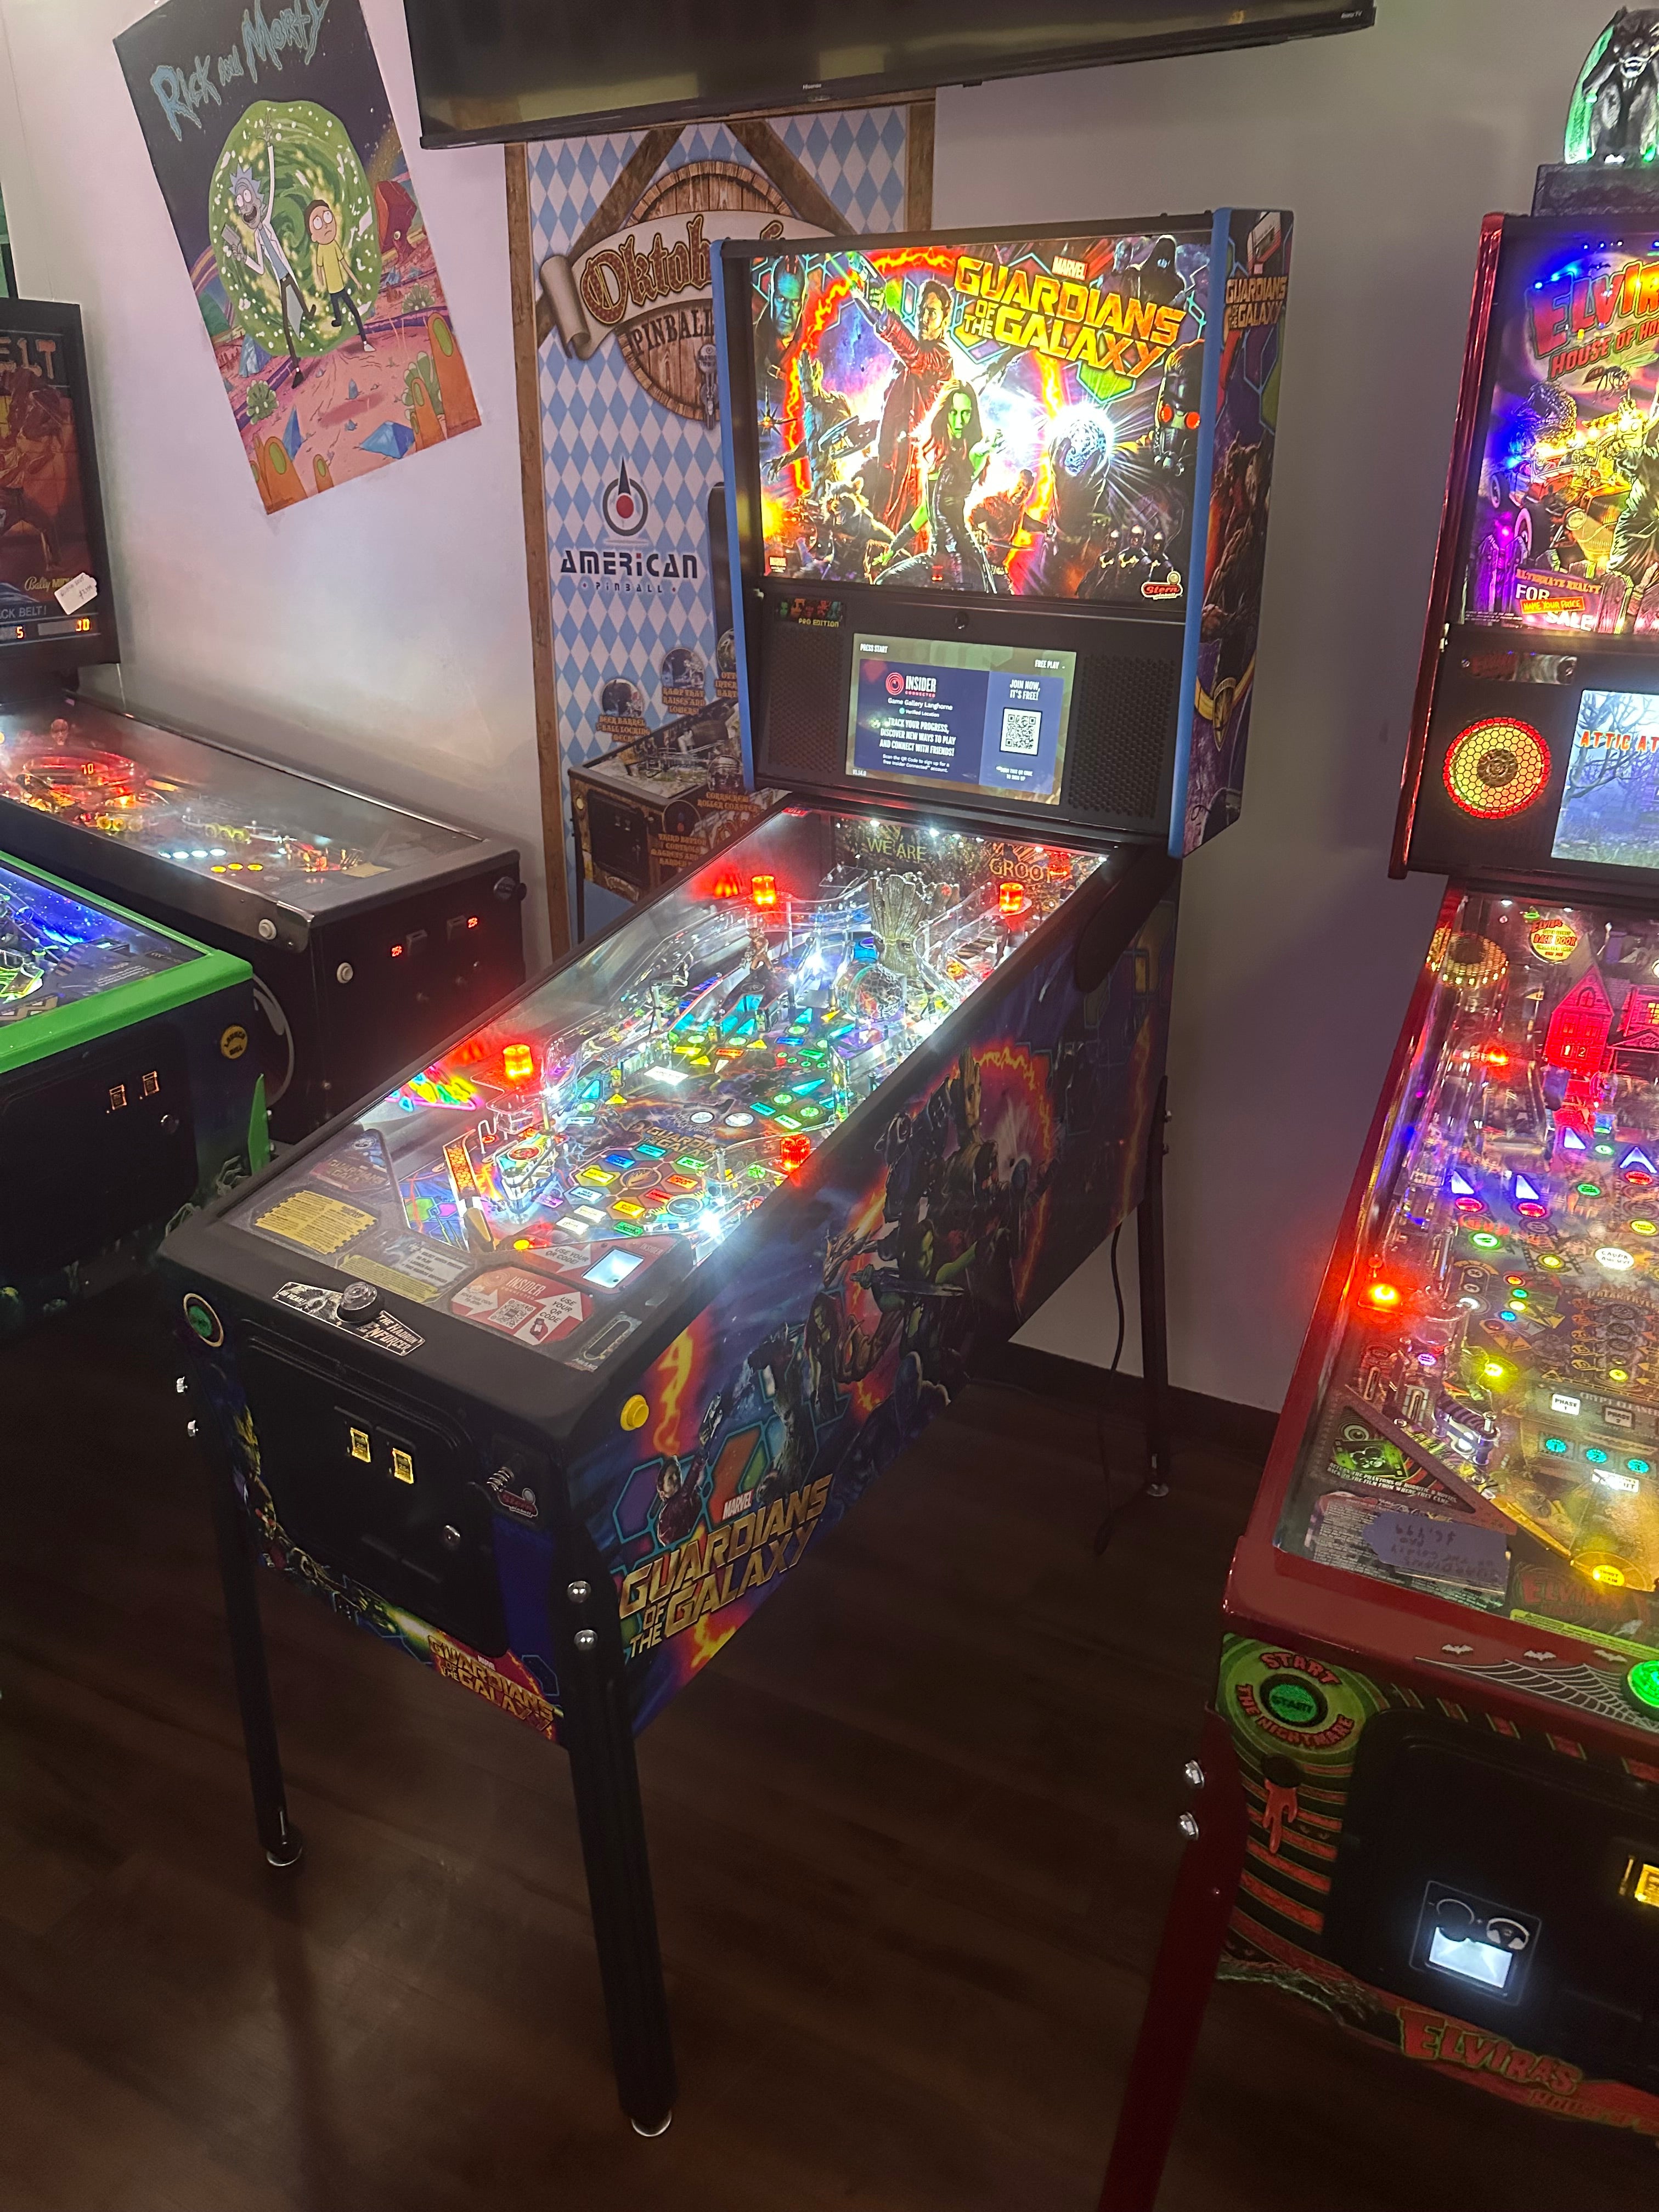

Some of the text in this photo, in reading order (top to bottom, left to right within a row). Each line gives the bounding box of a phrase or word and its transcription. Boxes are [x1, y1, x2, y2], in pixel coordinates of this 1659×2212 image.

[580, 213, 713, 325] Oktob
[1054, 257, 1086, 279] MARVEL
[1226, 276, 1288, 304] GUARDIANS
[954, 256, 1187, 346] GUARDIANS
[975, 300, 998, 320] OF
[1228, 301, 1283, 328] THE GALAXY
[963, 307, 1167, 379] THE GALAXY
[1550, 336, 1610, 380] HOUSE
[1616, 330, 1635, 351] OF
[25, 576, 50, 592] Bally
[596, 582, 662, 593] PINBALL
[1516, 584, 1550, 600] FOR
[0, 605, 47, 619] CK BELT!
[1523, 599, 1582, 611] NAME YOUR PRICE
[812, 619, 839, 628] EDITION
[1545, 611, 1594, 631] SALE
[860, 644, 888, 653] PRESS START
[1035, 659, 1059, 669] FREE PLAY
[905, 675, 936, 693] INSIDER
[1009, 679, 1041, 692] JOIN NOW,
[685, 689, 705, 698] THAT
[1009, 690, 1039, 701] IT'S FREE!
[663, 697, 706, 707] RAISES AND
[888, 697, 953, 711] Game Gallery Langhorne
[888, 718, 950, 734] TRACK YOUR PROGRESS,
[880, 728, 956, 746] DISCOVER NEW WAYS TO PLAY
[1580, 731, 1632, 751] ATTIC
[879, 739, 955, 757] AND CONNECT WITH FRIENDS!
[867, 839, 1052, 884] WE ARE GROOT
[1533, 934, 1577, 946] BACK DOOR
[1564, 1045, 1585, 1057] 1 2
[647, 1127, 718, 1152] GUARDIA
[555, 1248, 589, 1262] USE YOUR
[639, 1243, 664, 1255] INSIDER
[557, 1254, 580, 1265] CODE!
[505, 1276, 546, 1296] INSIDER
[552, 1301, 573, 1313] YOUR
[560, 1296, 577, 1306] USE
[539, 1312, 562, 1323] CODE
[357, 1321, 413, 1352] ENFORCER
[379, 1314, 419, 1345] THE HADRON
[1555, 1398, 1577, 1408] PHASE
[1579, 1392, 1613, 1406] CRYPT
[1607, 1410, 1630, 1420] PHASE
[1327, 1467, 1341, 1476] BACK
[1363, 1478, 1377, 1487] FILM
[1378, 1482, 1394, 1491] FROM
[1396, 1486, 1417, 1496] WHERE
[1418, 1491, 1432, 1499] THEY
[1352, 1469, 1363, 1477] THE
[1364, 1473, 1395, 1485] PHANTOMS
[723, 1489, 753, 1520] MARVEL
[619, 1474, 833, 1620] GUARDIANS
[664, 1519, 819, 1638] GALAXY
[643, 1598, 668, 1630] OF
[630, 1622, 663, 1658] THE
[441, 1667, 460, 1682] THE
[445, 1661, 457, 1672] OF
[1259, 1651, 1343, 1686] START
[428, 1634, 554, 1722] GUARDIANS
[1235, 1683, 1355, 1747] THE NIGHTMARE
